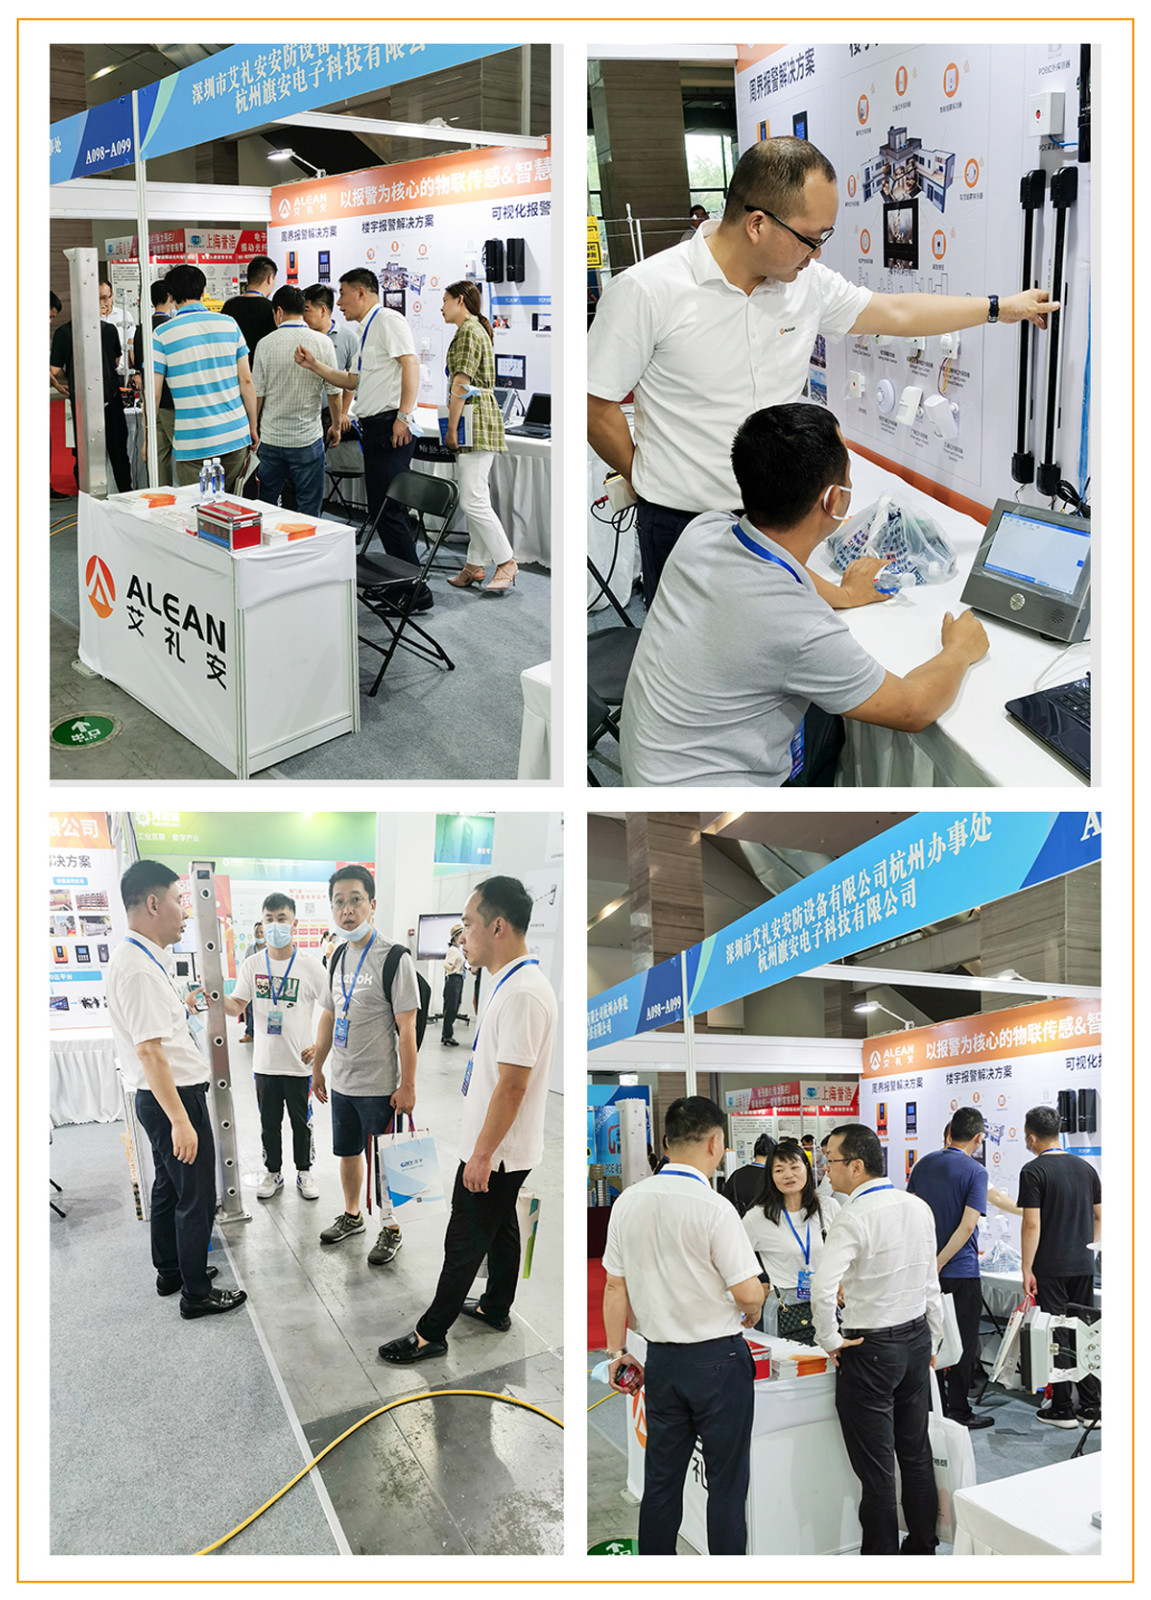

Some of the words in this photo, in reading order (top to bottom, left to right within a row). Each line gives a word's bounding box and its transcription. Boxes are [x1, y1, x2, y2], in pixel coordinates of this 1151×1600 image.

[748, 47, 816, 104] 周界报警解决方案
[85, 137, 132, 165] A098-A099
[293, 191, 327, 207] ALEAN
[491, 201, 551, 221] 可视化报警
[280, 226, 338, 244] 周界报警解决方案
[361, 214, 435, 235] 楼宇报警解决方案
[126, 574, 226, 655] ALEAN
[126, 605, 227, 691] 艾礼安
[71, 728, 101, 742] 出口
[725, 812, 992, 965] 深圳市艾礼安安防设备有限公司杭州办事处
[757, 877, 918, 974] 杭州旗安电子科技有限公司
[646, 995, 682, 1021] A098-A099
[883, 1045, 914, 1059] ALEAN
[871, 1076, 923, 1095] 周界报警解决方案
[945, 1065, 1013, 1086] 楼宇报警解决方案
